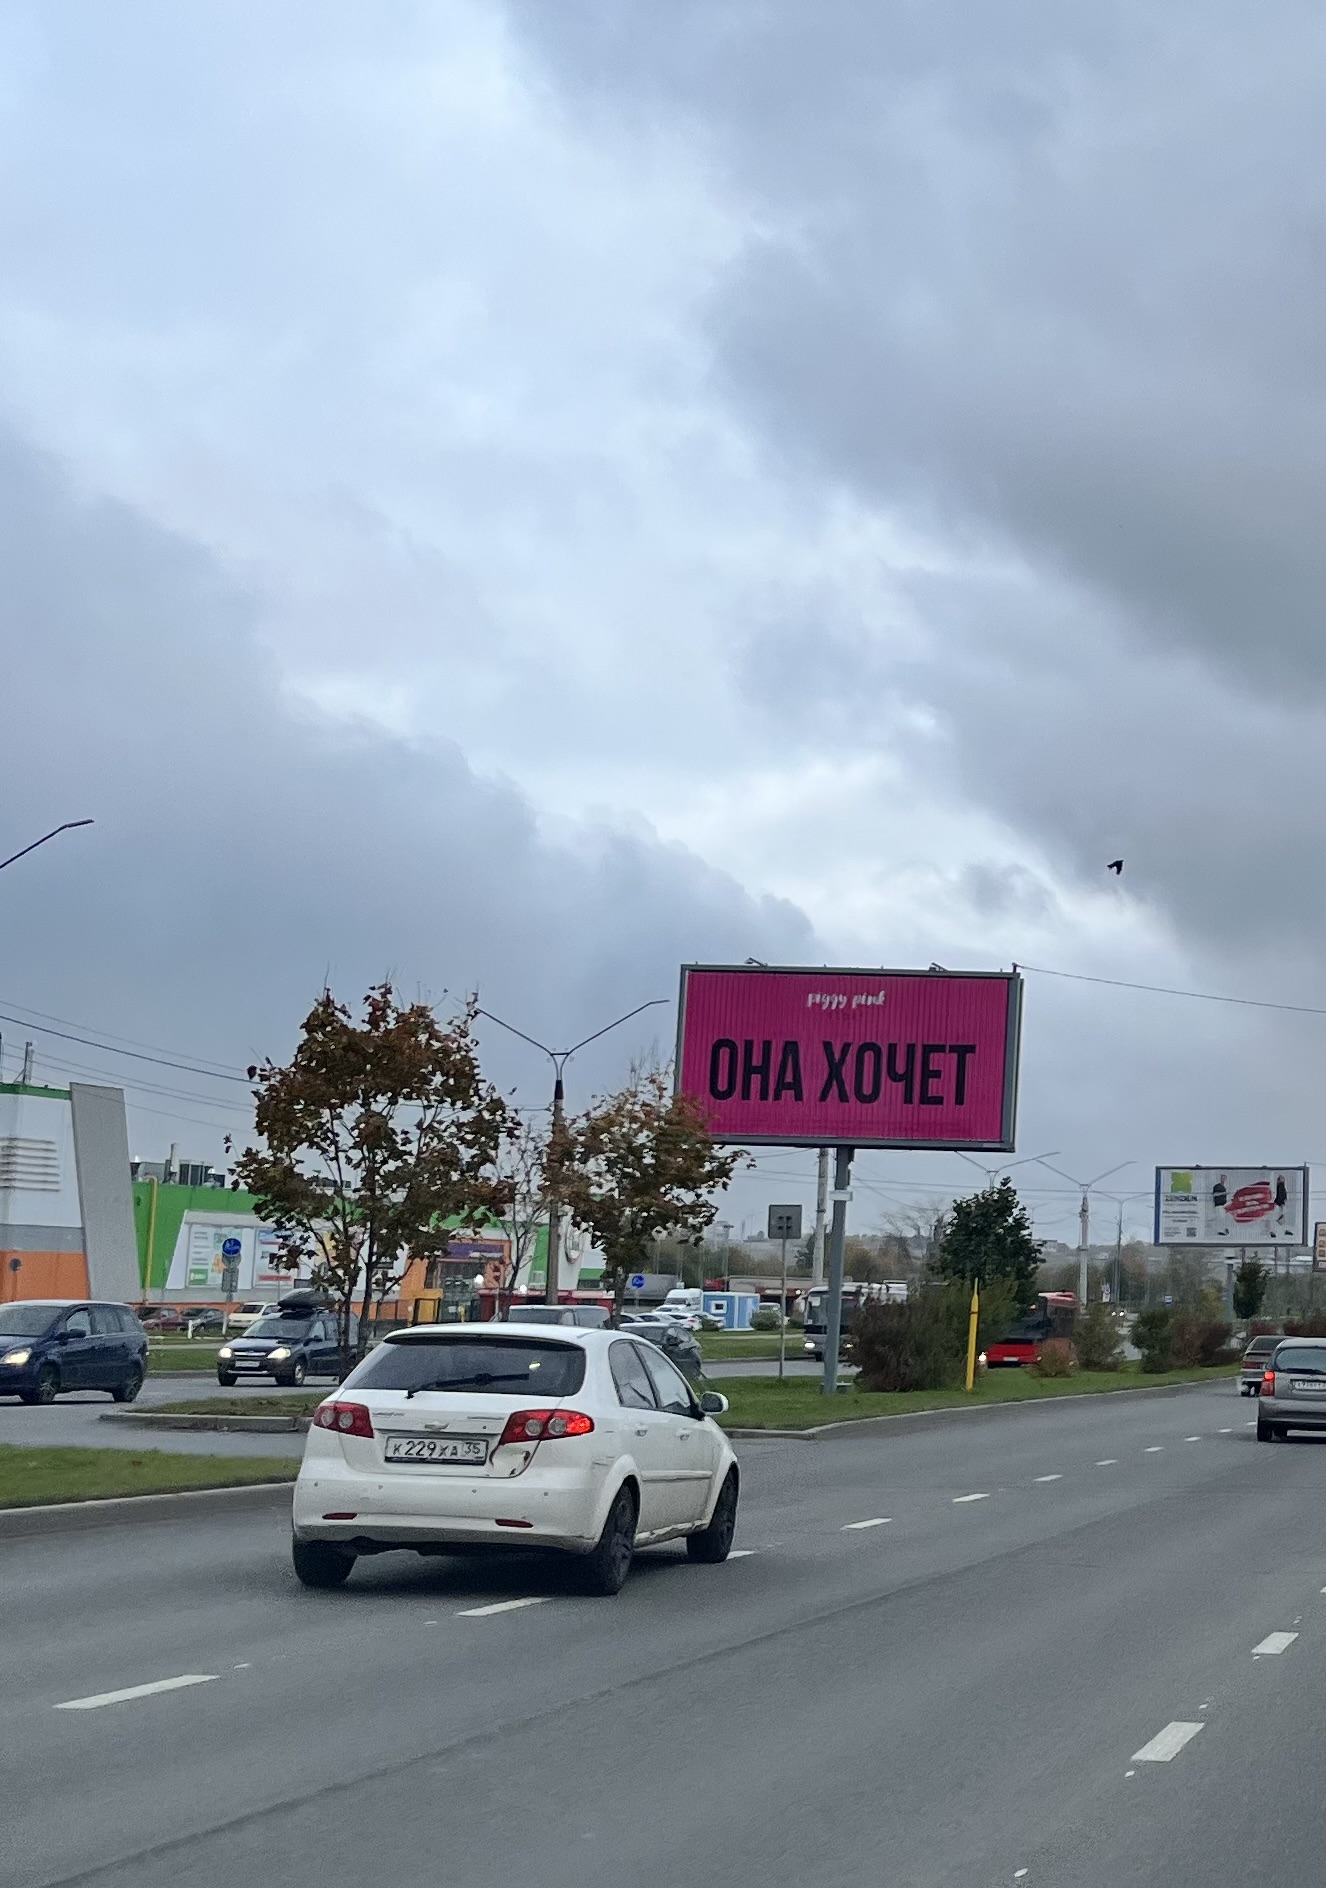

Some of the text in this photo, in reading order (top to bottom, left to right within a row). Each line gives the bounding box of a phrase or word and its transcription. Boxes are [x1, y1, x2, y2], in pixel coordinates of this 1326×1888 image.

[807, 990, 886, 1010] piggy pink
[709, 1037, 977, 1106] ОНА ХОЧЕТ
